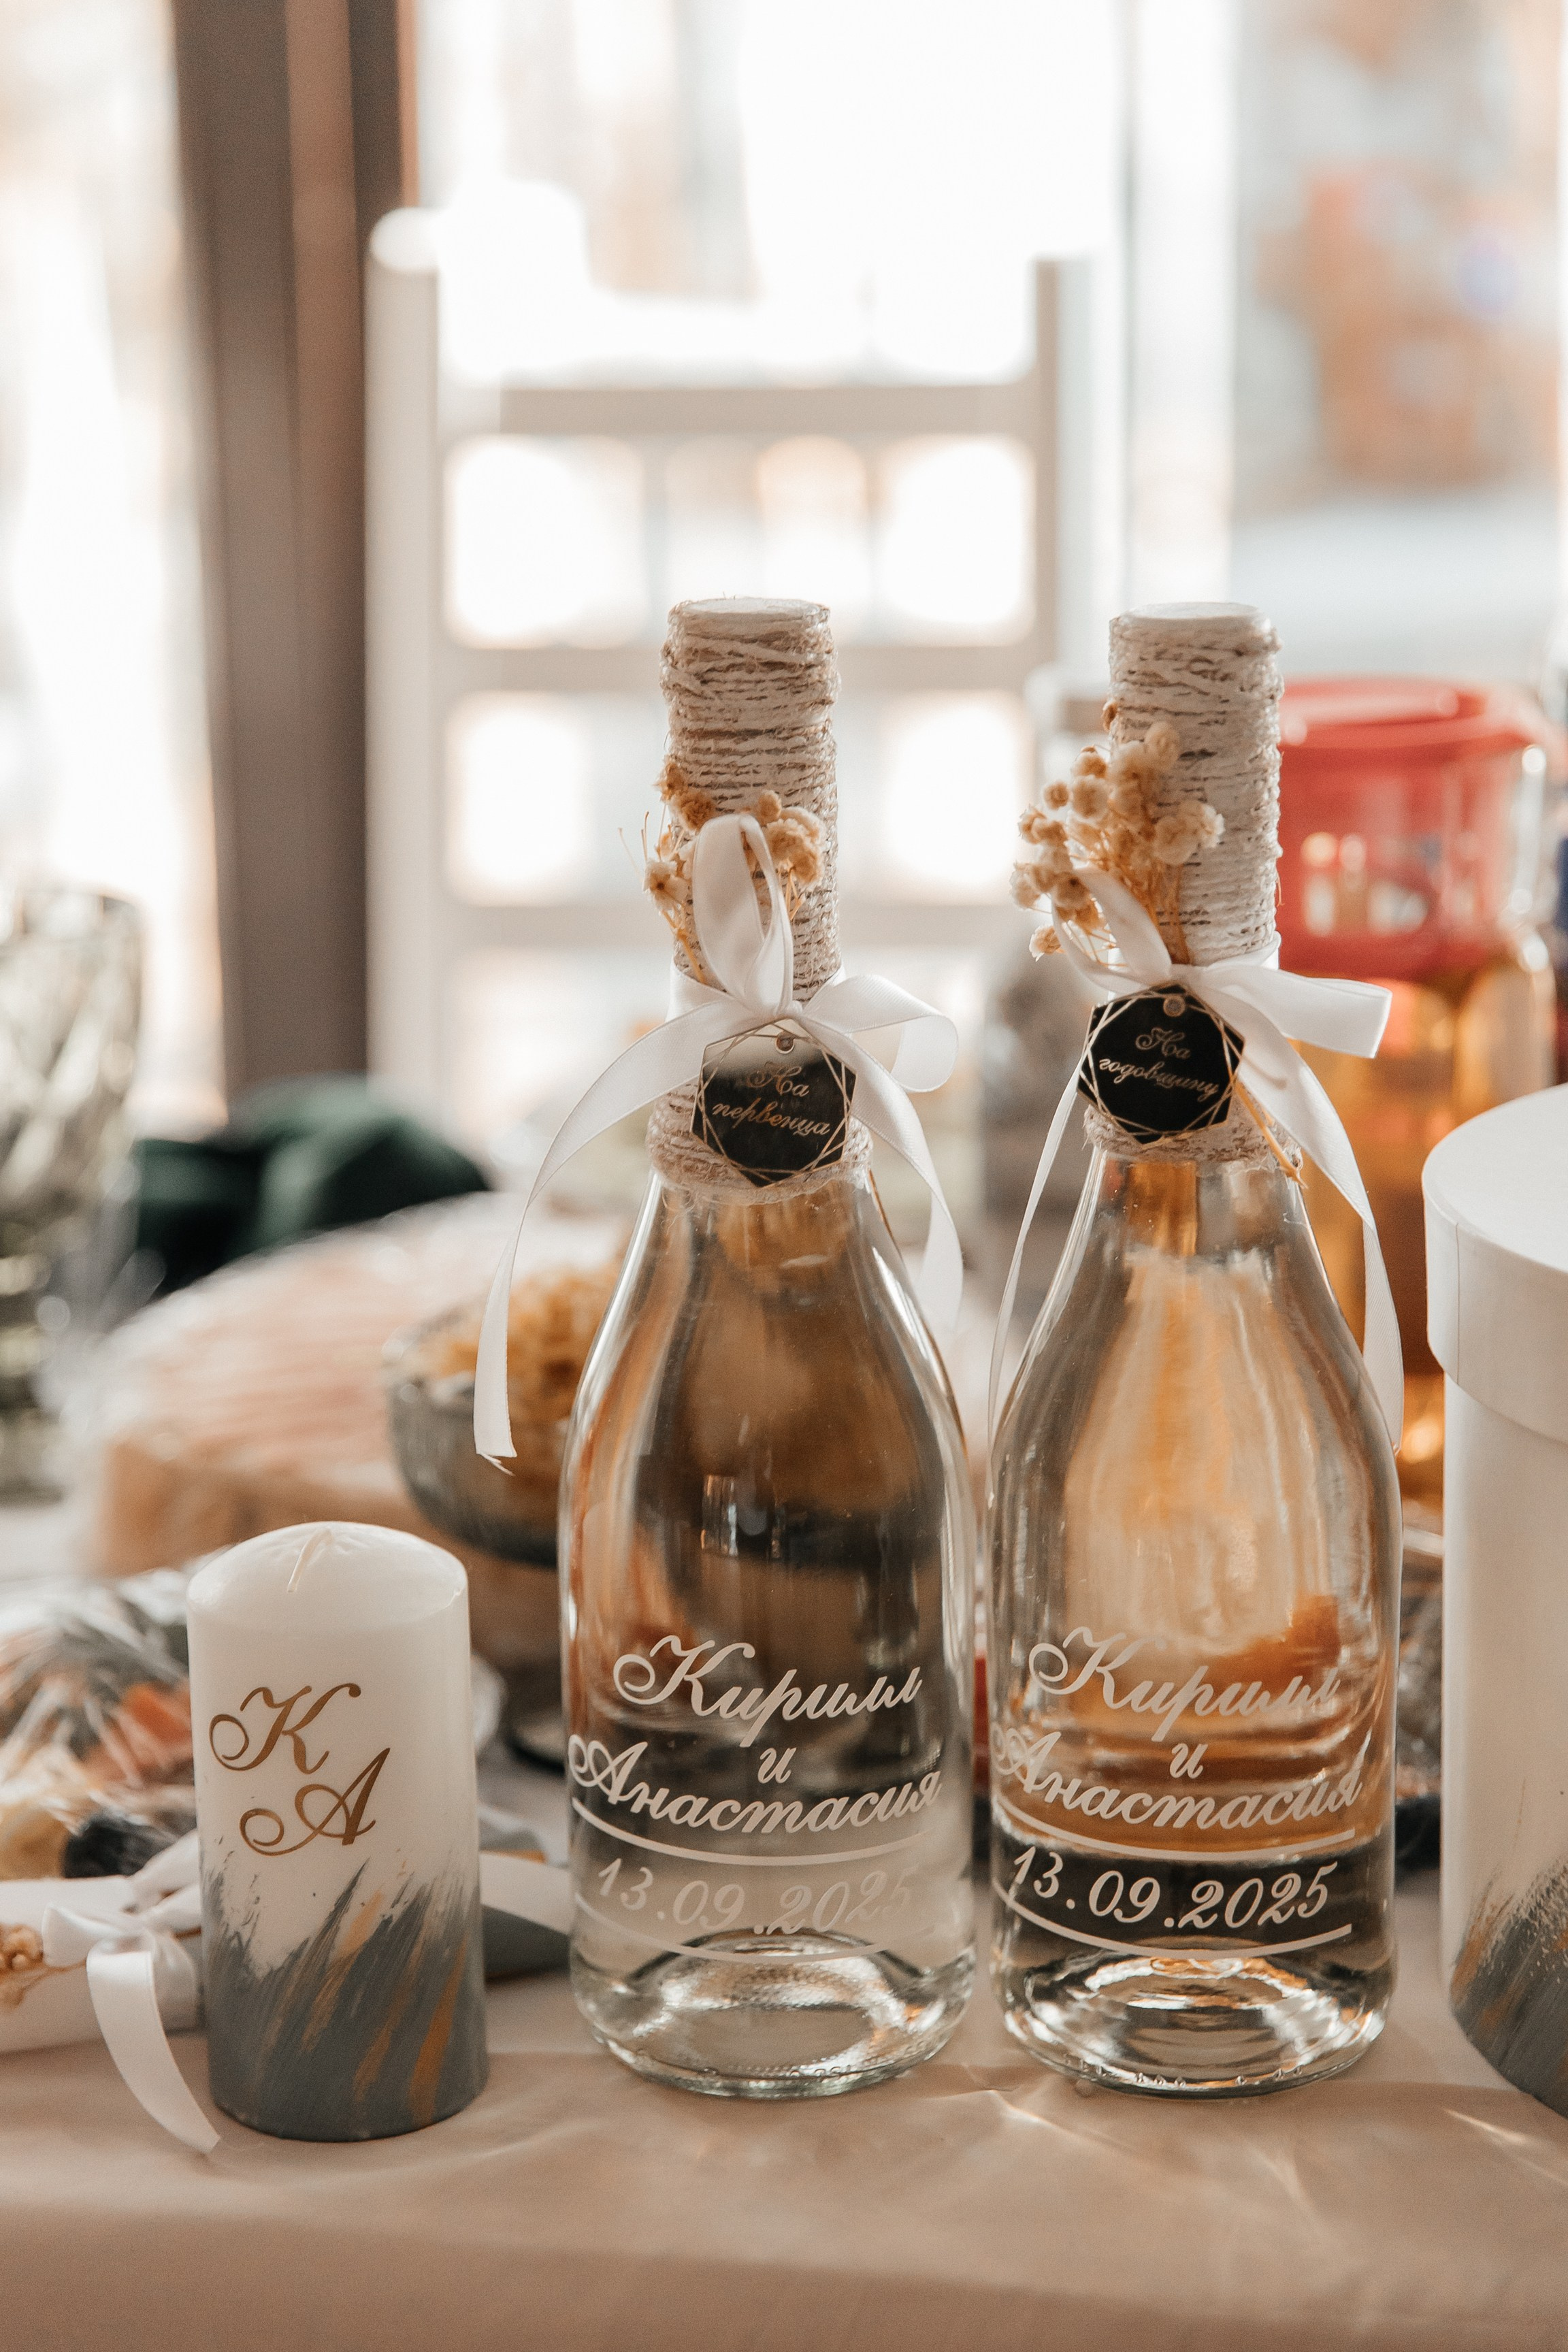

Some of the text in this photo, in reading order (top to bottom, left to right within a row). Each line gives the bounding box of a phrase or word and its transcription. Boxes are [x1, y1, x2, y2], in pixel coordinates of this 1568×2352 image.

[748, 1062, 809, 1097] На
[1135, 1027, 1190, 1060] На
[612, 1635, 923, 1747] Кирилл
[1028, 1627, 1340, 1742] Кирилл
[568, 1734, 942, 1833] Анастасия
[757, 1747, 796, 1784] и
[992, 1722, 1362, 1830] Анастасия
[1169, 1742, 1209, 1779] и
[598, 1858, 916, 1936] 13.09.2025
[1008, 1846, 1338, 1929] 13.09.2025
